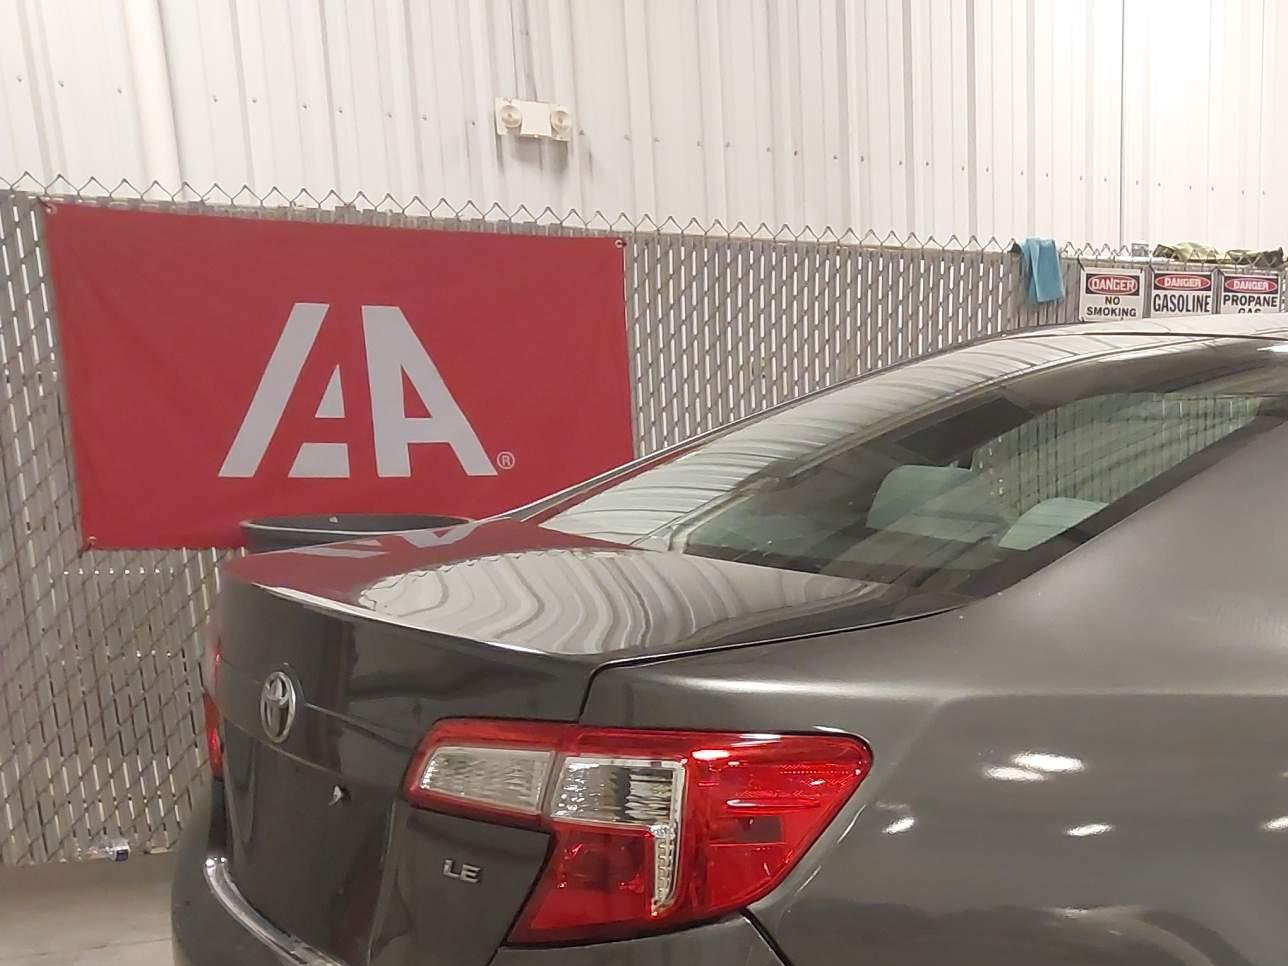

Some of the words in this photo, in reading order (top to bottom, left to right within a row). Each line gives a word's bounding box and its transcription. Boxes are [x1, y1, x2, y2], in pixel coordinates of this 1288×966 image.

[1091, 277, 1135, 292] DANGER
[1163, 277, 1201, 287] DANGER
[1233, 280, 1269, 290] DANGER
[1104, 296, 1120, 305] NO
[1153, 293, 1211, 313] GASOLINE
[1223, 294, 1278, 307] PROPANE
[1086, 306, 1137, 317] SMOKING
[443, 859, 481, 883] LE
